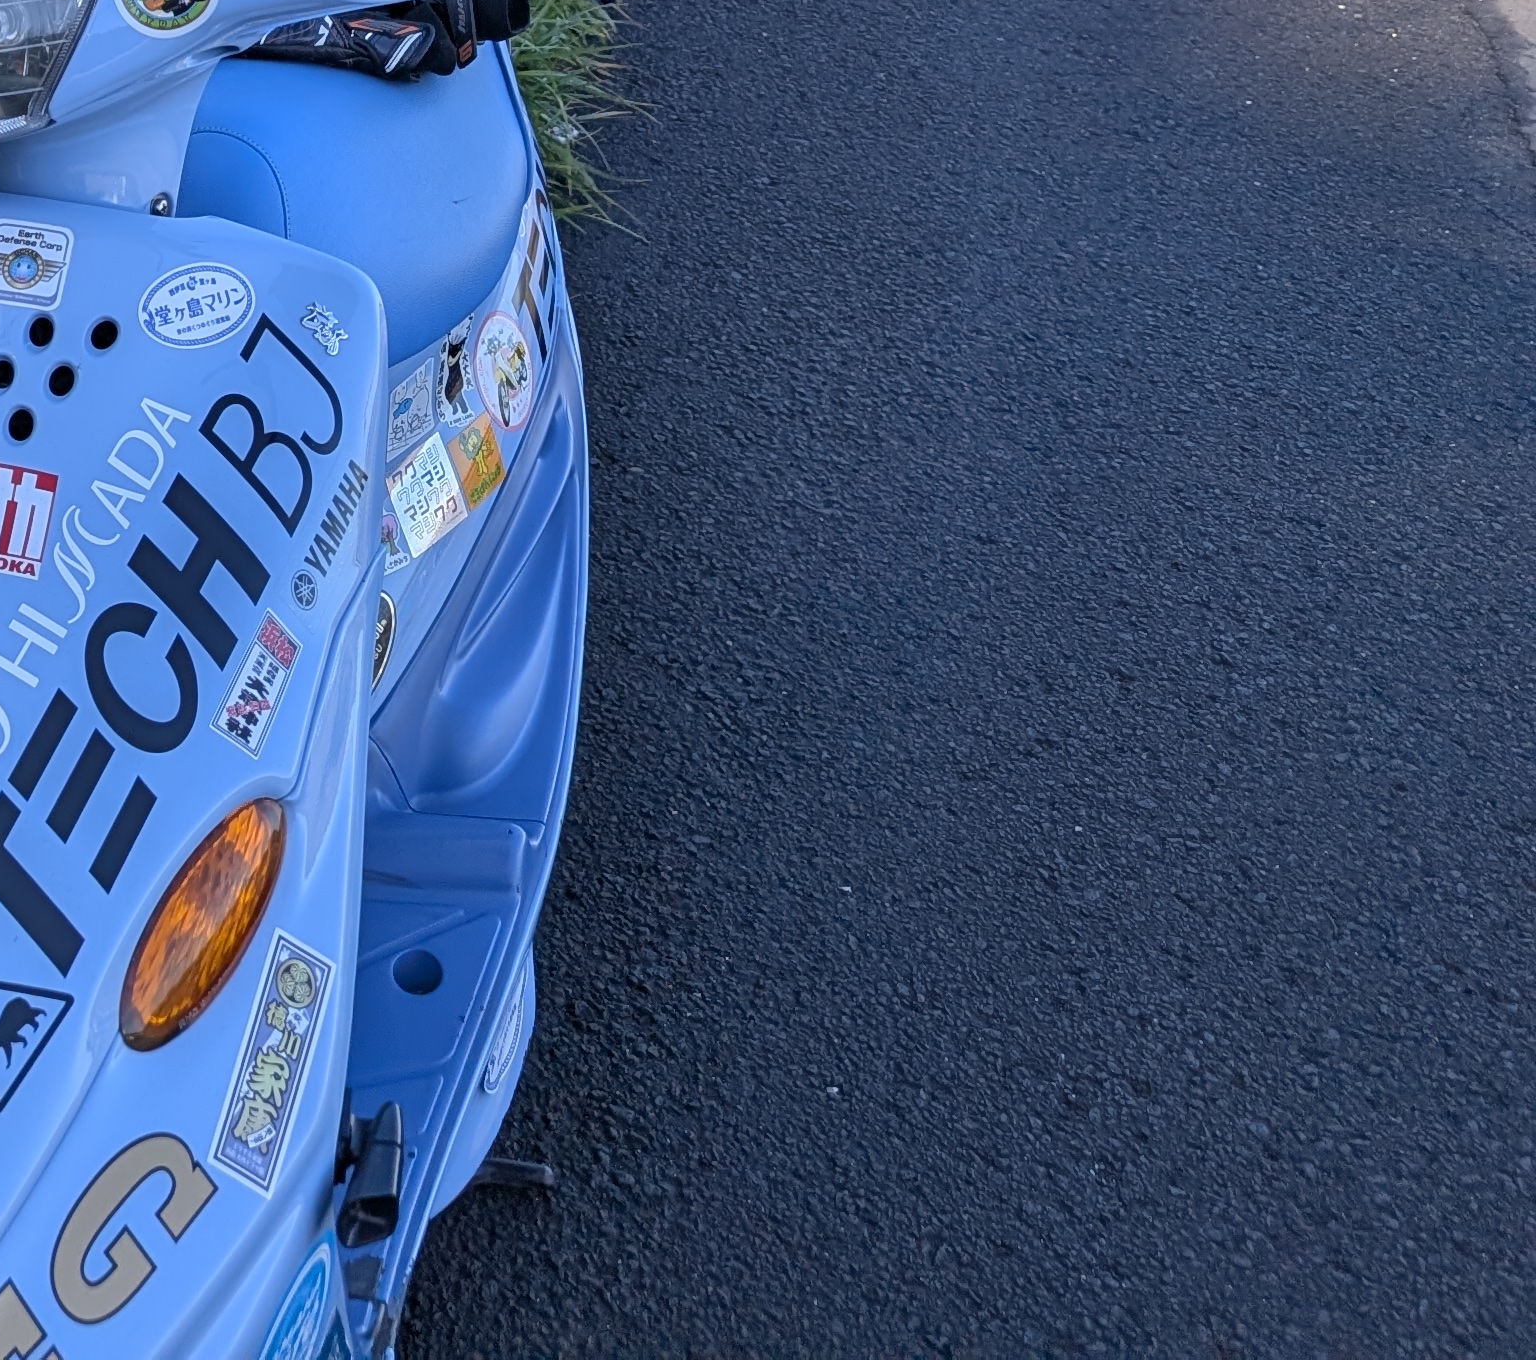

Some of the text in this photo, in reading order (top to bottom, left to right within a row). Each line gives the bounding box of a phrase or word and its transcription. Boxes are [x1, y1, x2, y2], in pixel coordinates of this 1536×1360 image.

[17, 229, 45, 240] Earth
[39, 240, 63, 252] Corp
[153, 283, 247, 328] 堂ヶ島マリン
[199, 313, 343, 538] BJ
[304, 458, 369, 577] YAMAHA
